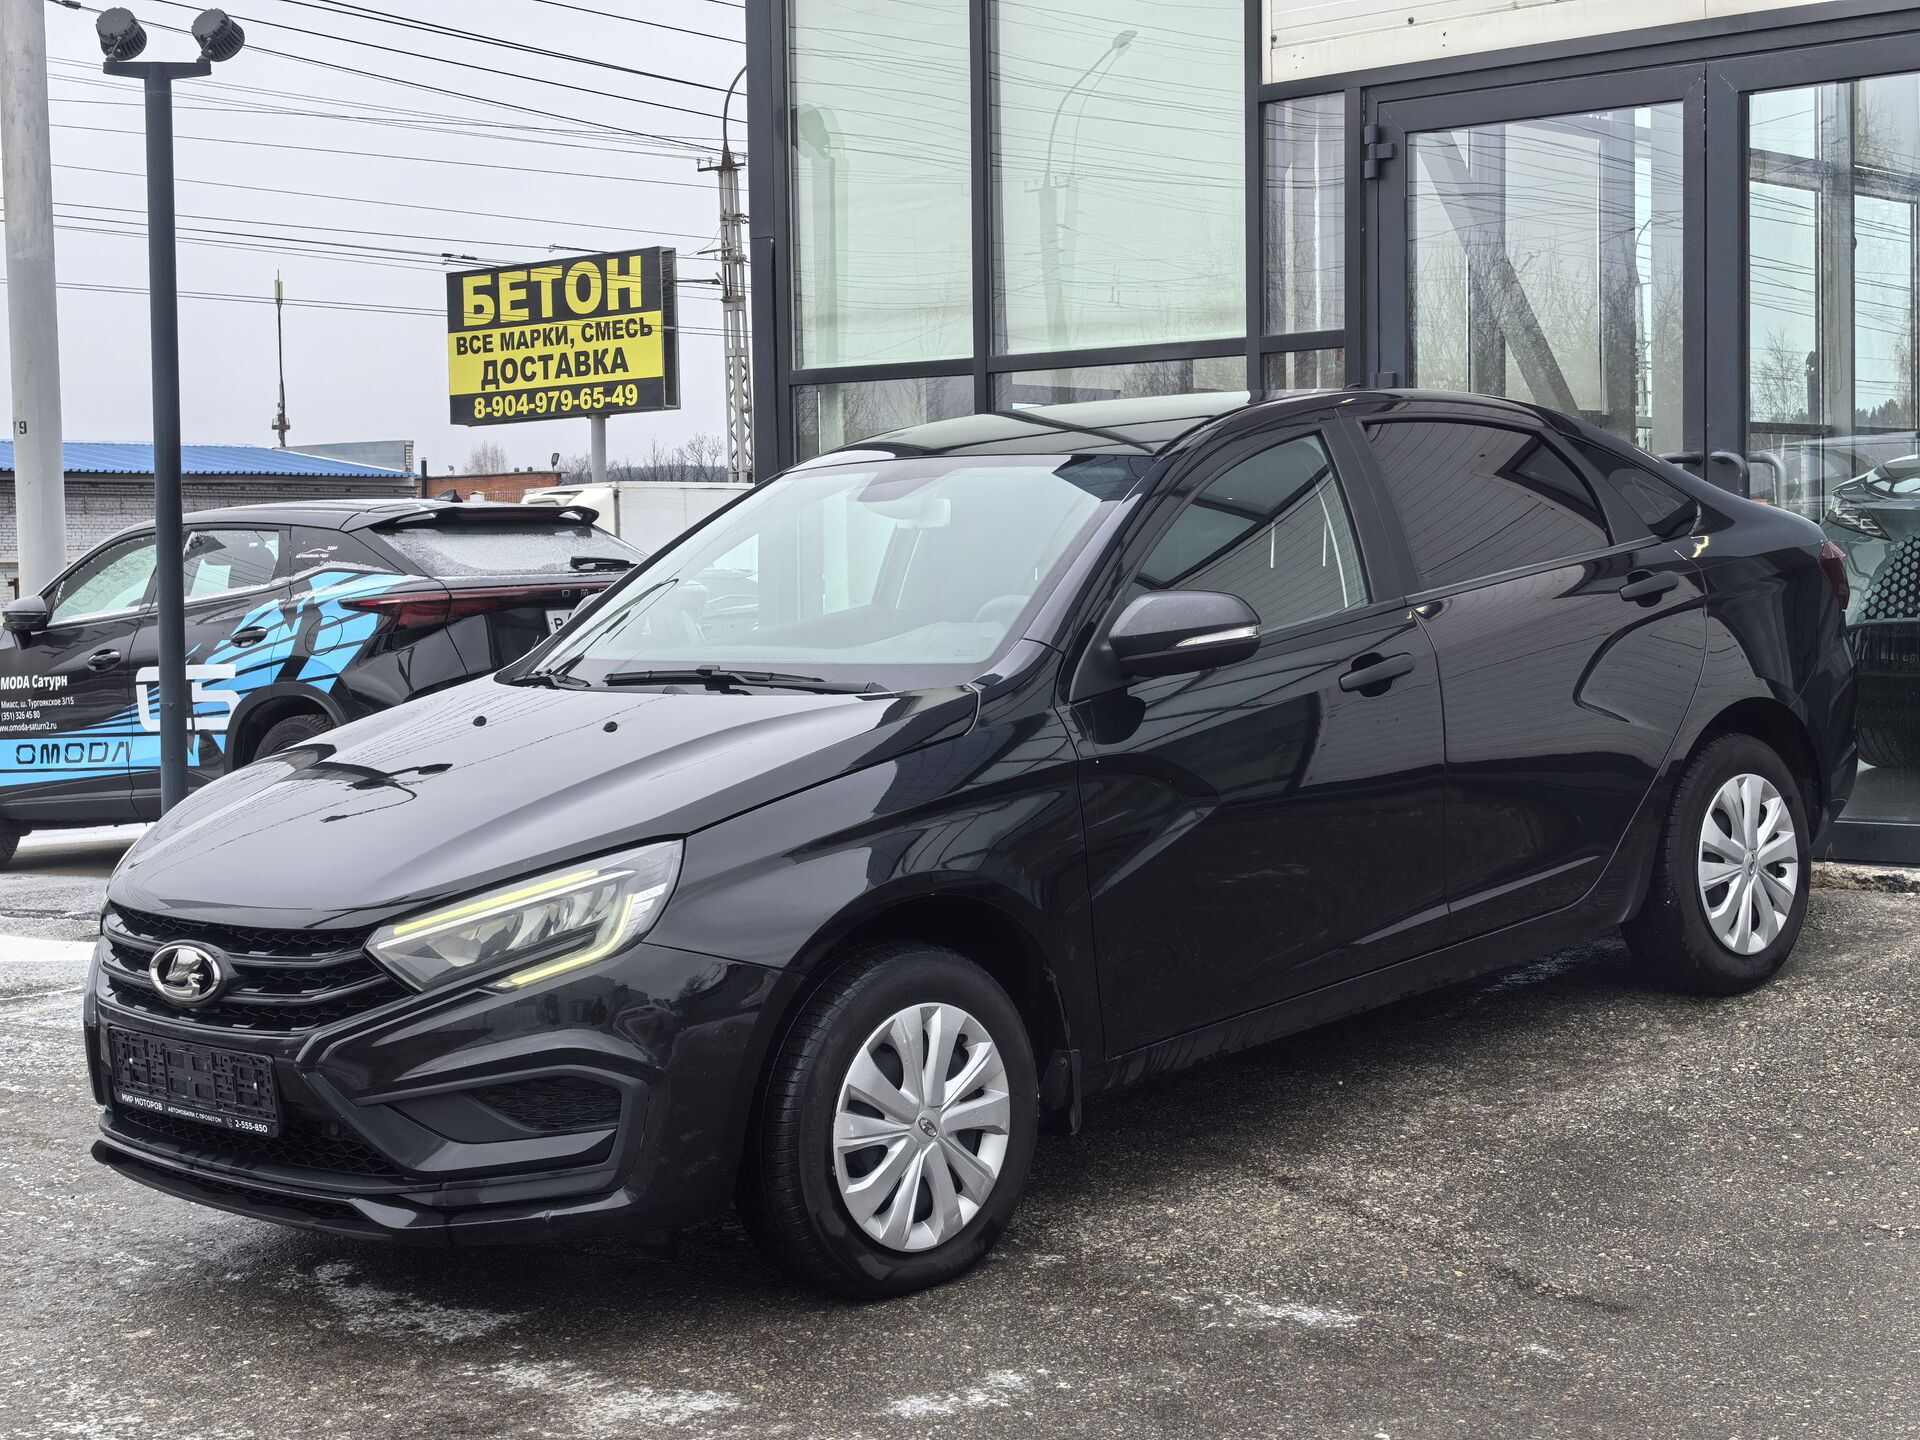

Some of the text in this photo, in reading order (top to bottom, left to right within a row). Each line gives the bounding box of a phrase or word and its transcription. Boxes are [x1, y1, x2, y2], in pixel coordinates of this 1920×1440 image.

[462, 255, 642, 327] БЕТОН
[456, 317, 653, 355] ВСЕ МАРКИ, СМЕСЬ
[481, 347, 629, 391] ДОСТАВКА
[473, 384, 639, 419] 8-904-979-65-49
[31, 674, 68, 691] Сатурн
[0, 701, 20, 709] Миасс,
[28, 699, 61, 709] Тургоякское
[61, 696, 75, 706] 3/15
[1, 710, 41, 722] (351) 326 45 80
[16, 741, 130, 765] OMODA
[121, 1093, 134, 1103] МИР
[134, 1096, 163, 1111] МОТОРОВ
[234, 1119, 268, 1133] 2-555-850
